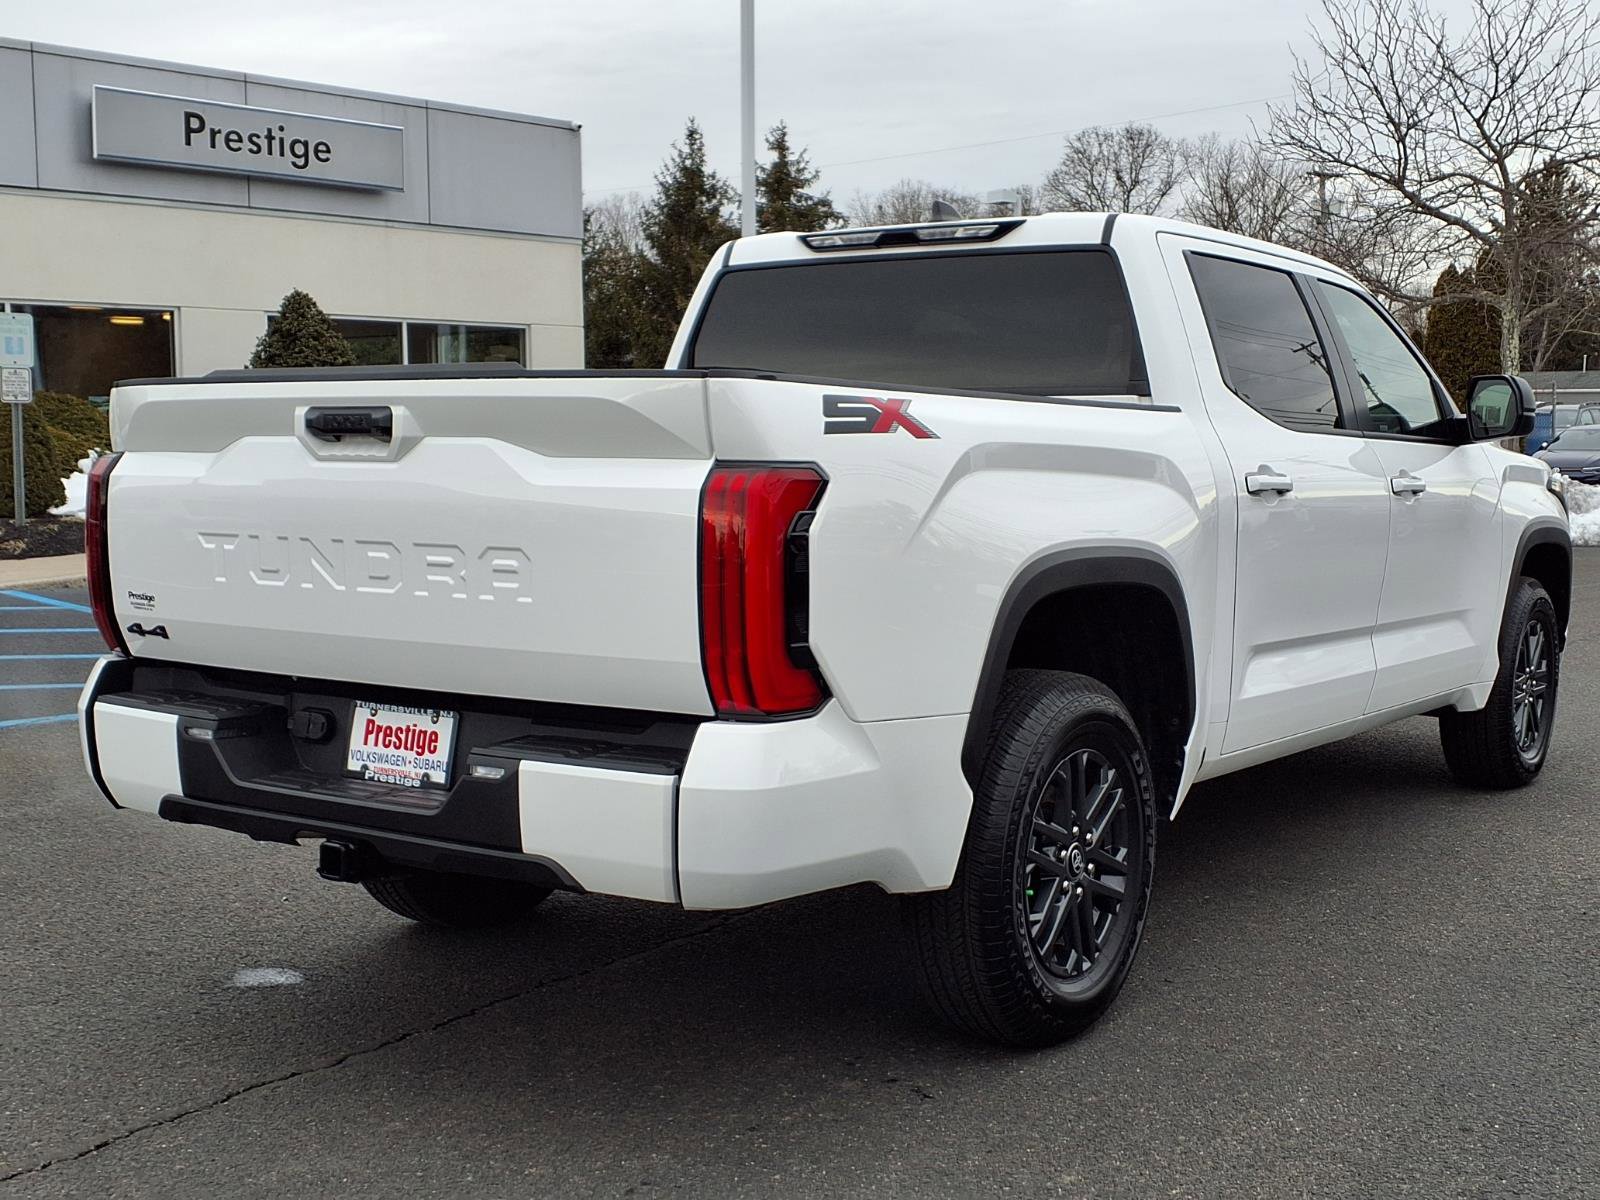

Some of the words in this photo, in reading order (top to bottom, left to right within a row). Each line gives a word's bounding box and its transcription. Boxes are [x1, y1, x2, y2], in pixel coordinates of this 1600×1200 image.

[184, 111, 331, 170] Prestige
[198, 532, 534, 604] TUNDRA
[127, 590, 155, 603] Prestige
[439, 710, 454, 718] NJ
[363, 718, 439, 757] Prestige
[351, 748, 407, 767] VOLKSWAGEN
[412, 756, 449, 773] SUBARU
[364, 770, 421, 788] Prestige
